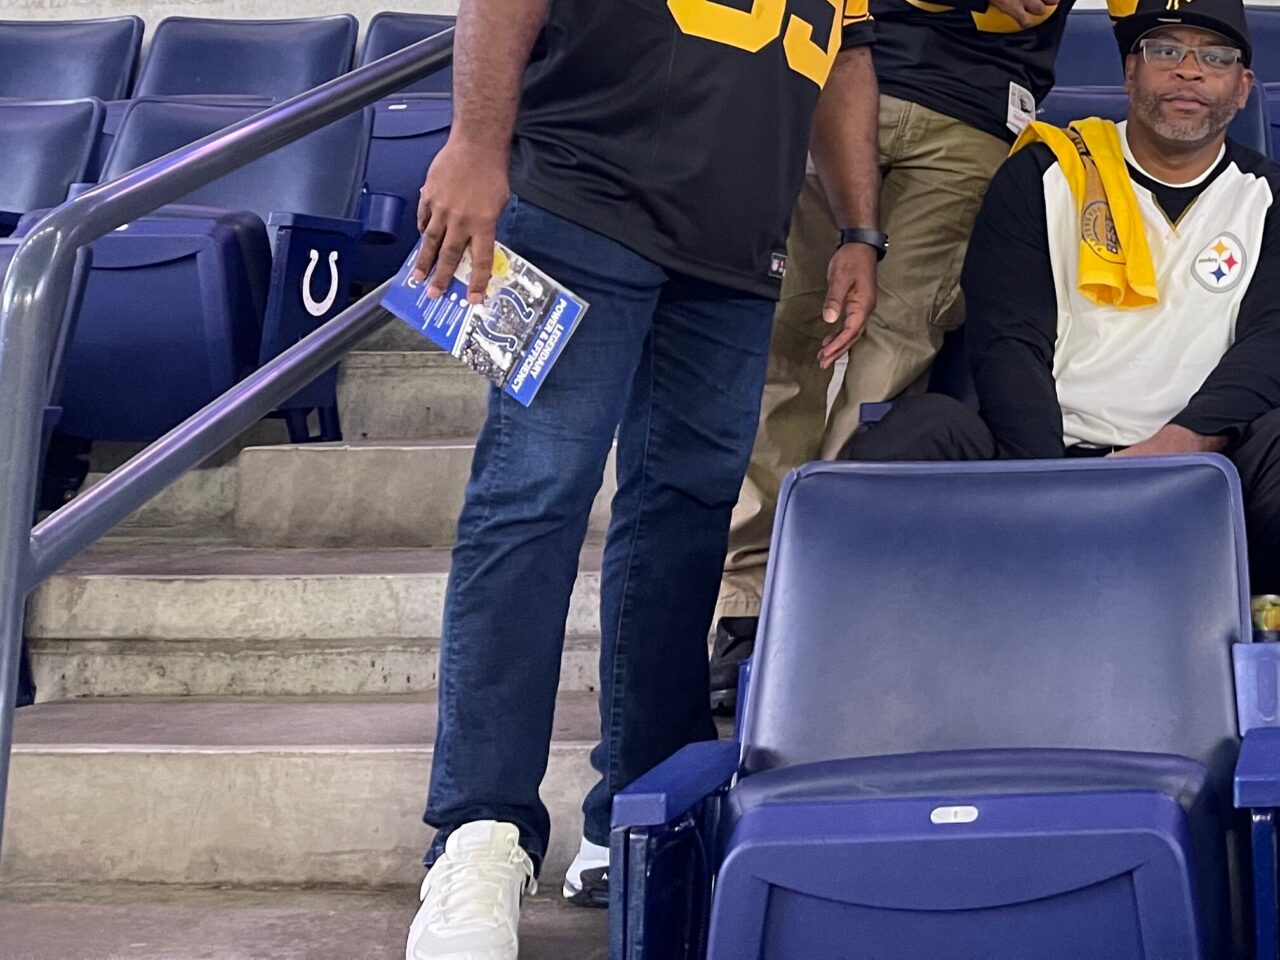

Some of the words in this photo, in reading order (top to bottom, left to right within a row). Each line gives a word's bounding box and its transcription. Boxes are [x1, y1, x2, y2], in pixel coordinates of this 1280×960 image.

[544, 298, 568, 335] POWER
[511, 339, 544, 394] EFFICIENCY
[531, 324, 564, 379] LEGENDARY
